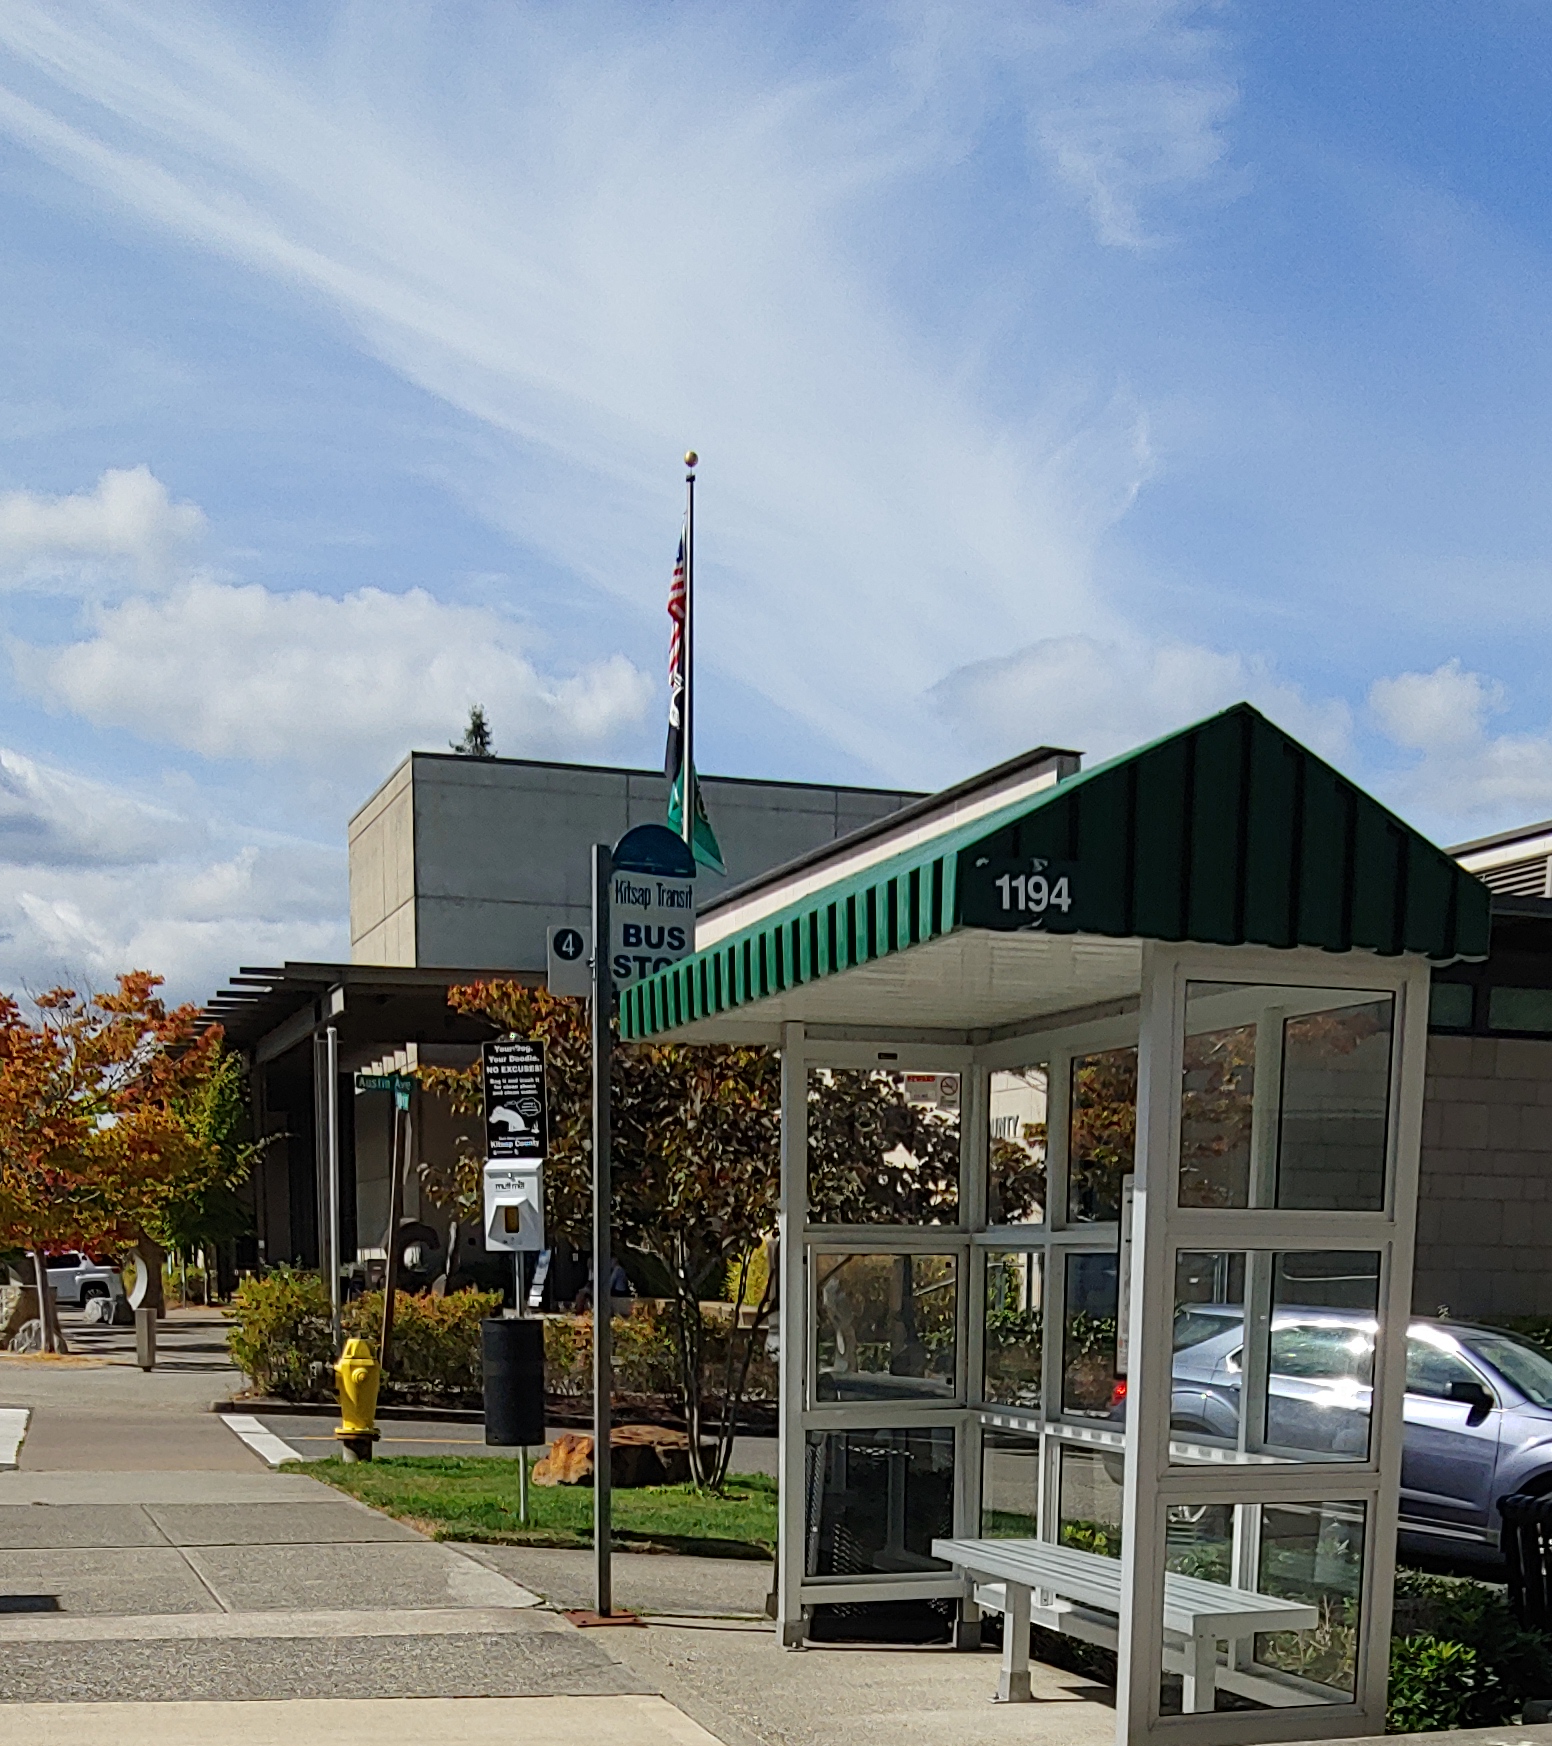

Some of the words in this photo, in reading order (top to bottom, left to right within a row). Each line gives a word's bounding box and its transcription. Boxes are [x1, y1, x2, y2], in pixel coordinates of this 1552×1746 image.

[615, 879, 651, 910] Kitsap
[656, 882, 693, 909] Transit
[995, 873, 1072, 913] 1194
[561, 932, 575, 957] 4
[623, 923, 686, 950] BUS
[613, 954, 681, 980] STO
[359, 1076, 391, 1089] Austin
[486, 1066, 499, 1074] NO
